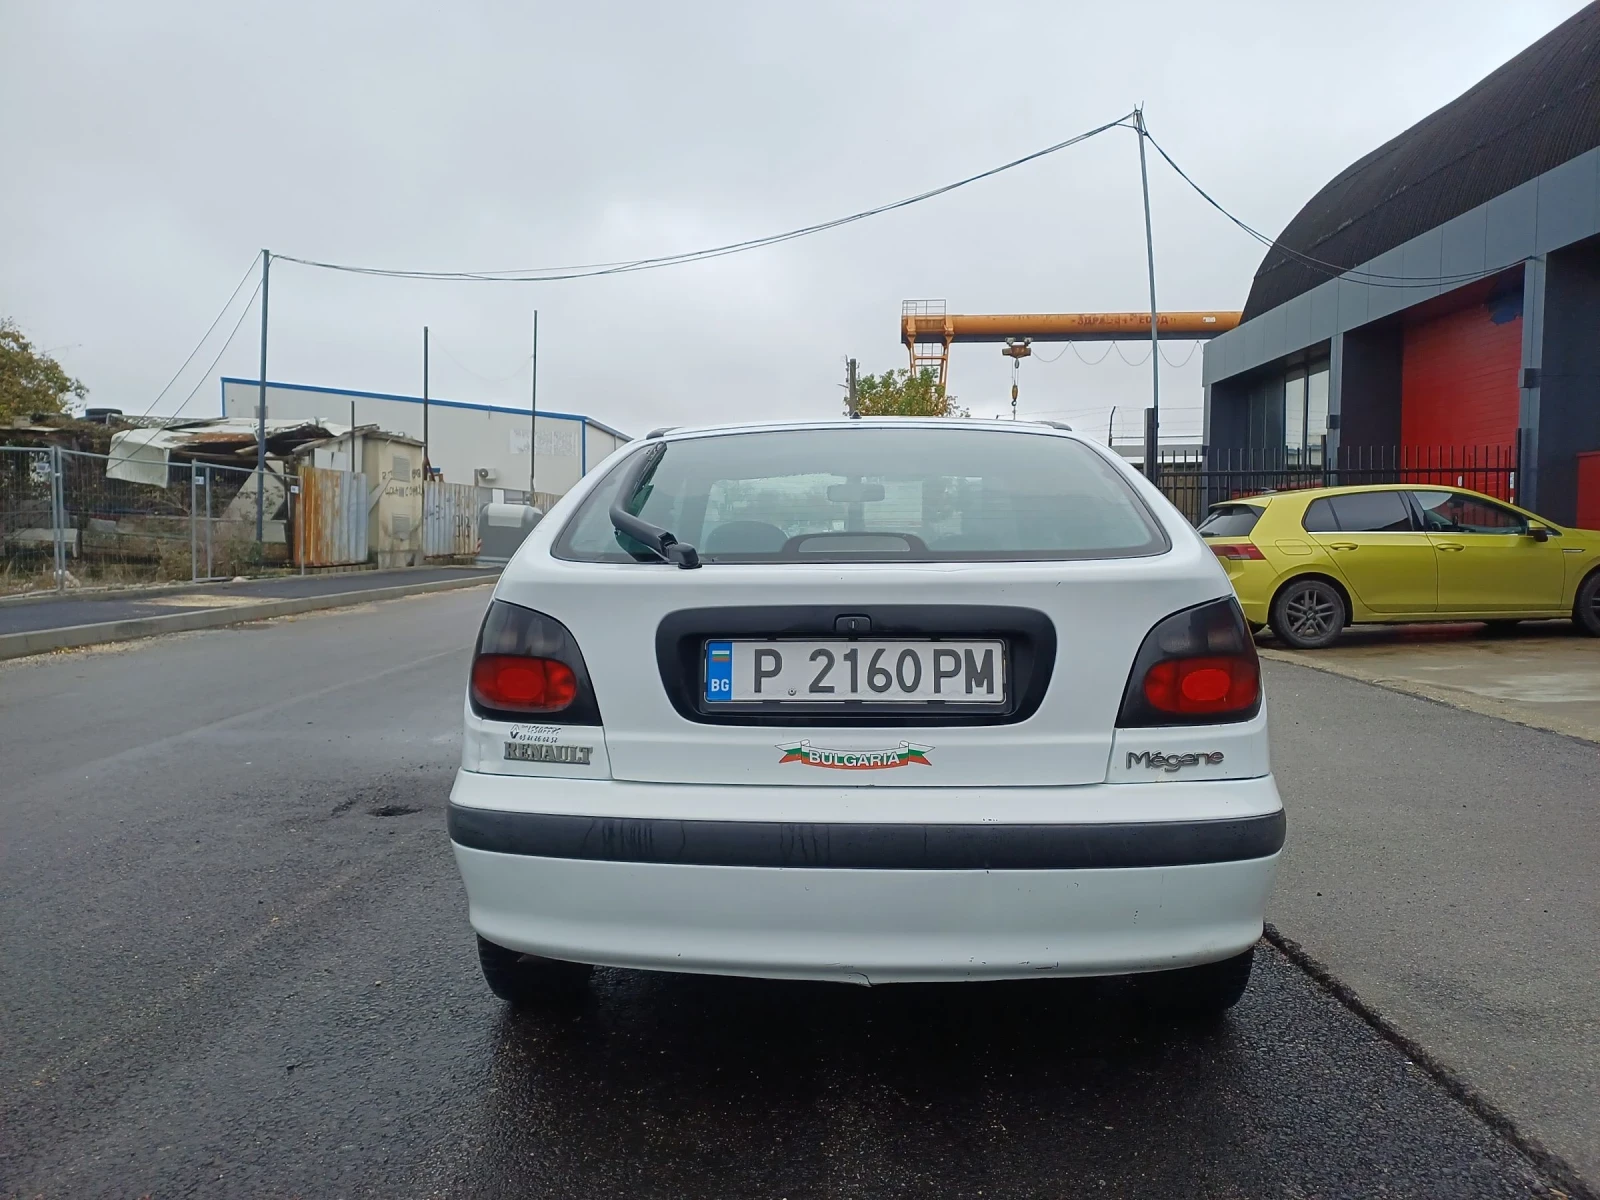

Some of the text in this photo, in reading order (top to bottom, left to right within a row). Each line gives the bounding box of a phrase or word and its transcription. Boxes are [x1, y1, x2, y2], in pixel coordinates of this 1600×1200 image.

[753, 647, 995, 694] P 2160 PM
[711, 678, 730, 692] BG
[503, 741, 593, 765] RENAULT
[808, 750, 901, 767] BULGARIA
[1125, 750, 1225, 773] Mégane
